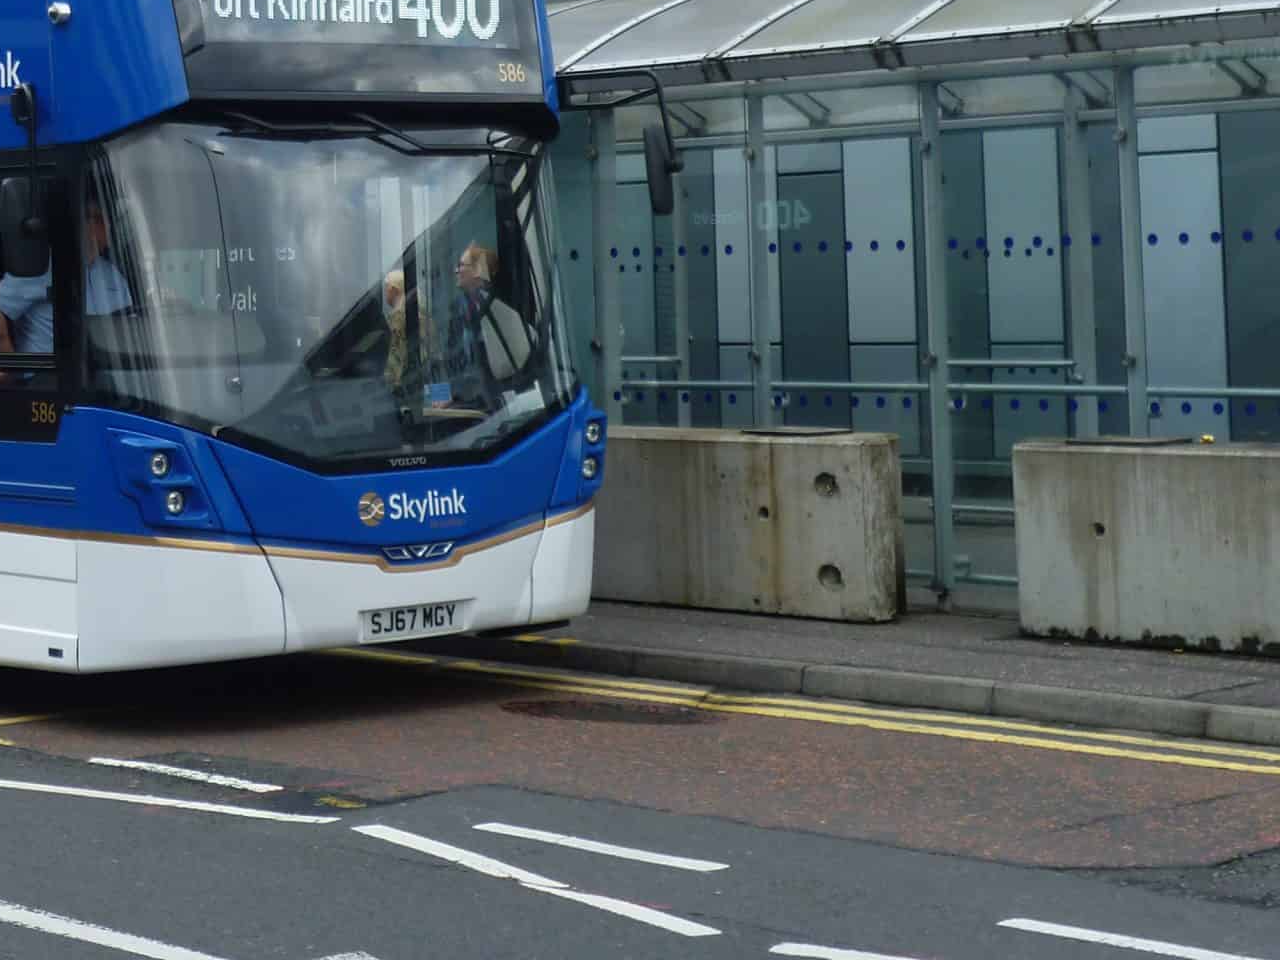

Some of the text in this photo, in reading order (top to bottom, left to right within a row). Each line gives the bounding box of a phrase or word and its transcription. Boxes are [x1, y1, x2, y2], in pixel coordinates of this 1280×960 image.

[498, 62, 526, 83] 586
[31, 401, 56, 423] 586
[390, 455, 427, 467] VOLVO
[389, 488, 466, 523] Skylink
[371, 604, 456, 634] SJ67 MGY
